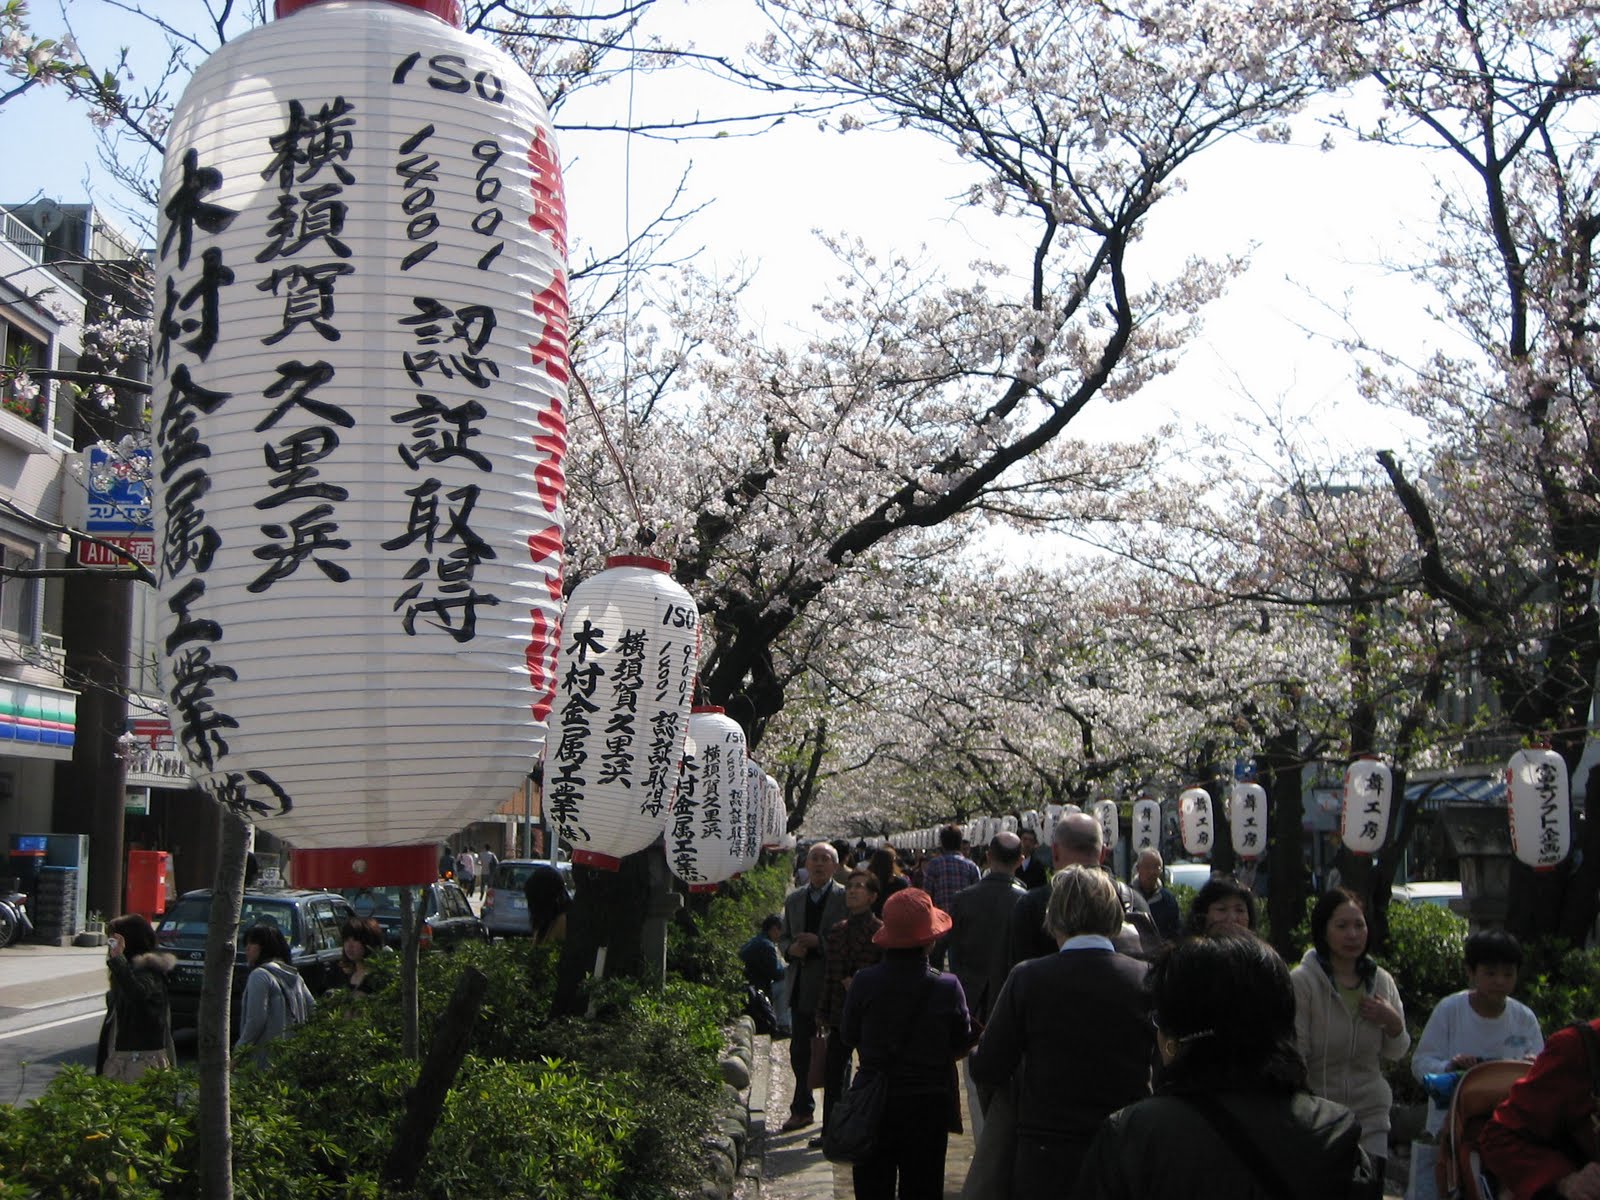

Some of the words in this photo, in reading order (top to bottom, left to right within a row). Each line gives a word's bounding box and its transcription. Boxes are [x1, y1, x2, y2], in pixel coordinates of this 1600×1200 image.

[392, 51, 506, 104] ISO
[396, 123, 440, 271] 14001
[471, 139, 504, 271] 9001
[246, 96, 356, 594] 横須賀久里浜
[381, 296, 500, 643] 認証取得
[662, 603, 695, 630] ISO
[678, 644, 692, 706] 9001
[597, 628, 648, 789] 横須賀久里浜
[701, 744, 722, 840] 横須賀久里浜
